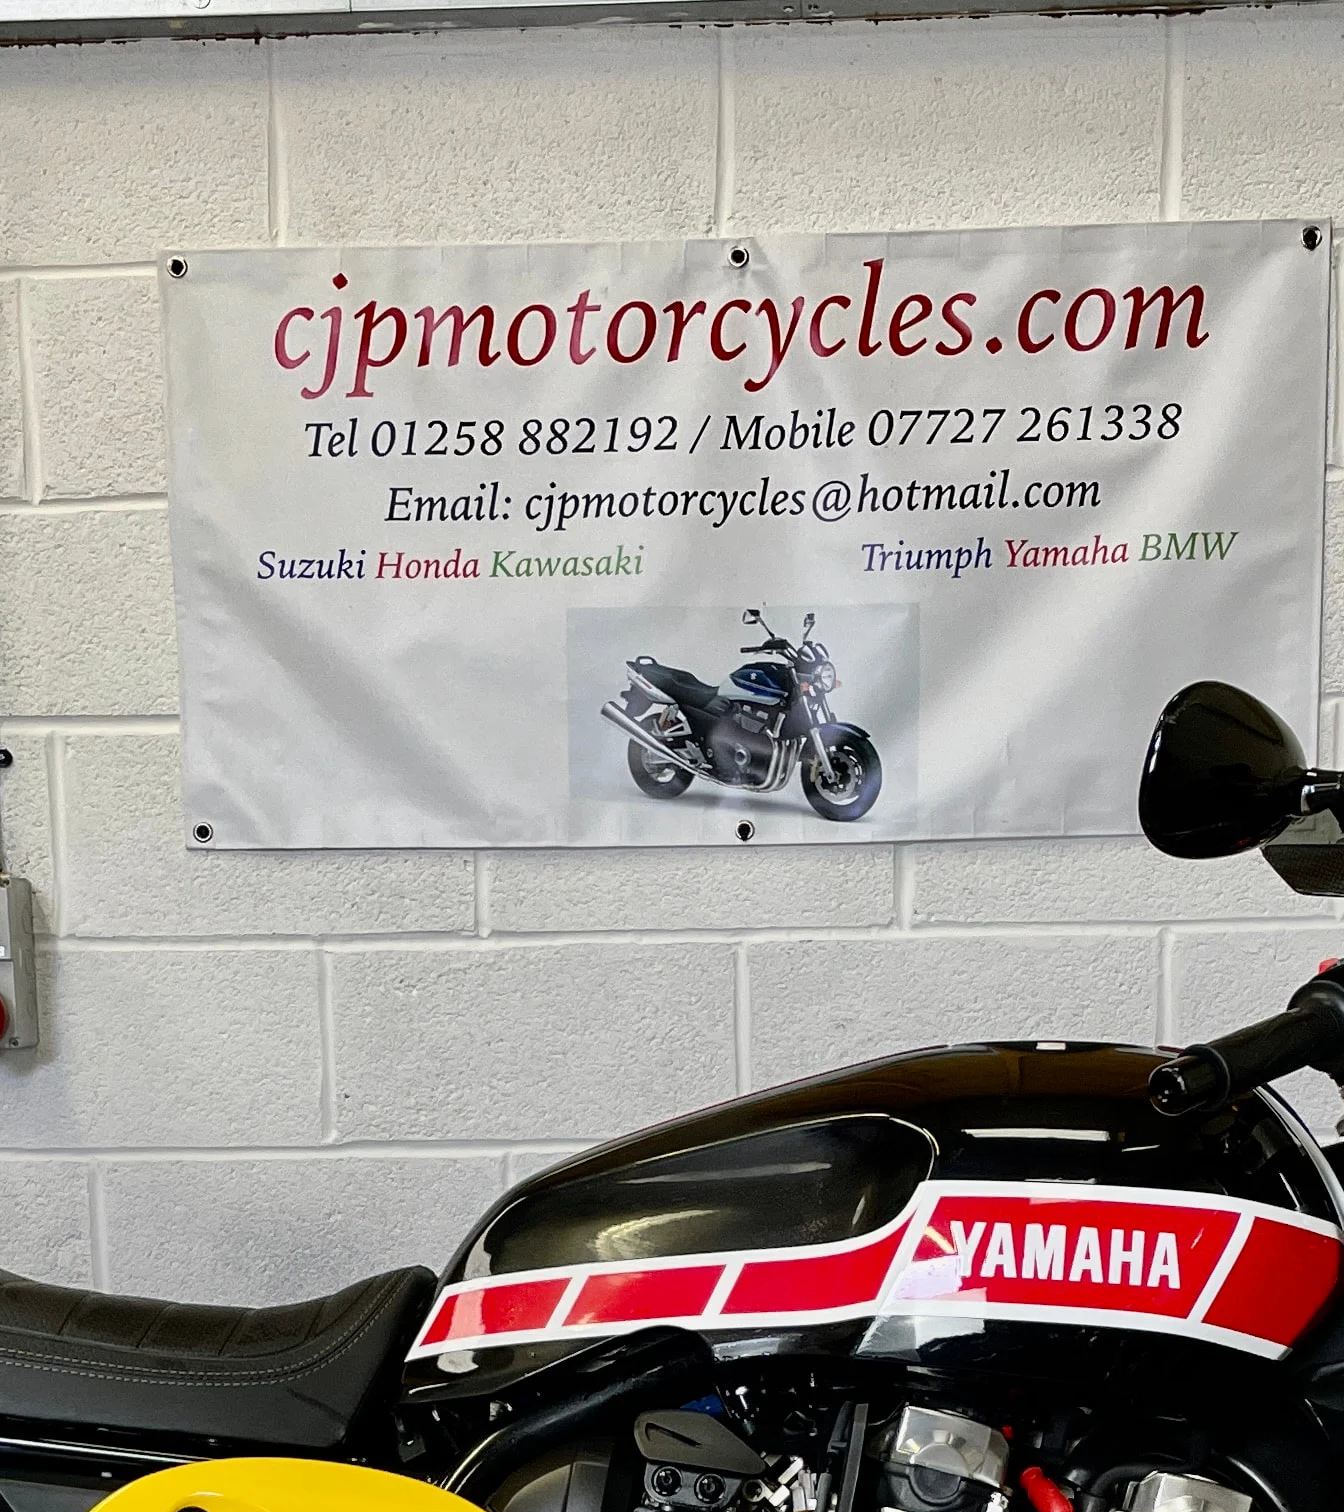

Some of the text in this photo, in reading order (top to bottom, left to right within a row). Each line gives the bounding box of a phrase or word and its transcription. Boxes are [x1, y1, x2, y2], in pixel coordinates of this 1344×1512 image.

[273, 259, 1210, 399] cjpmotorcycles.com
[305, 402, 1183, 458] Tel 01258 882192 / Mobile 07727 261338
[384, 469, 1102, 531] Email: cjpmotorcycles@hotmail.com
[256, 545, 645, 580] Suzuki Honda Kawasaki
[860, 530, 1240, 577] Triumph Yamaha BMW
[949, 1220, 1181, 1290] YAMAHA
